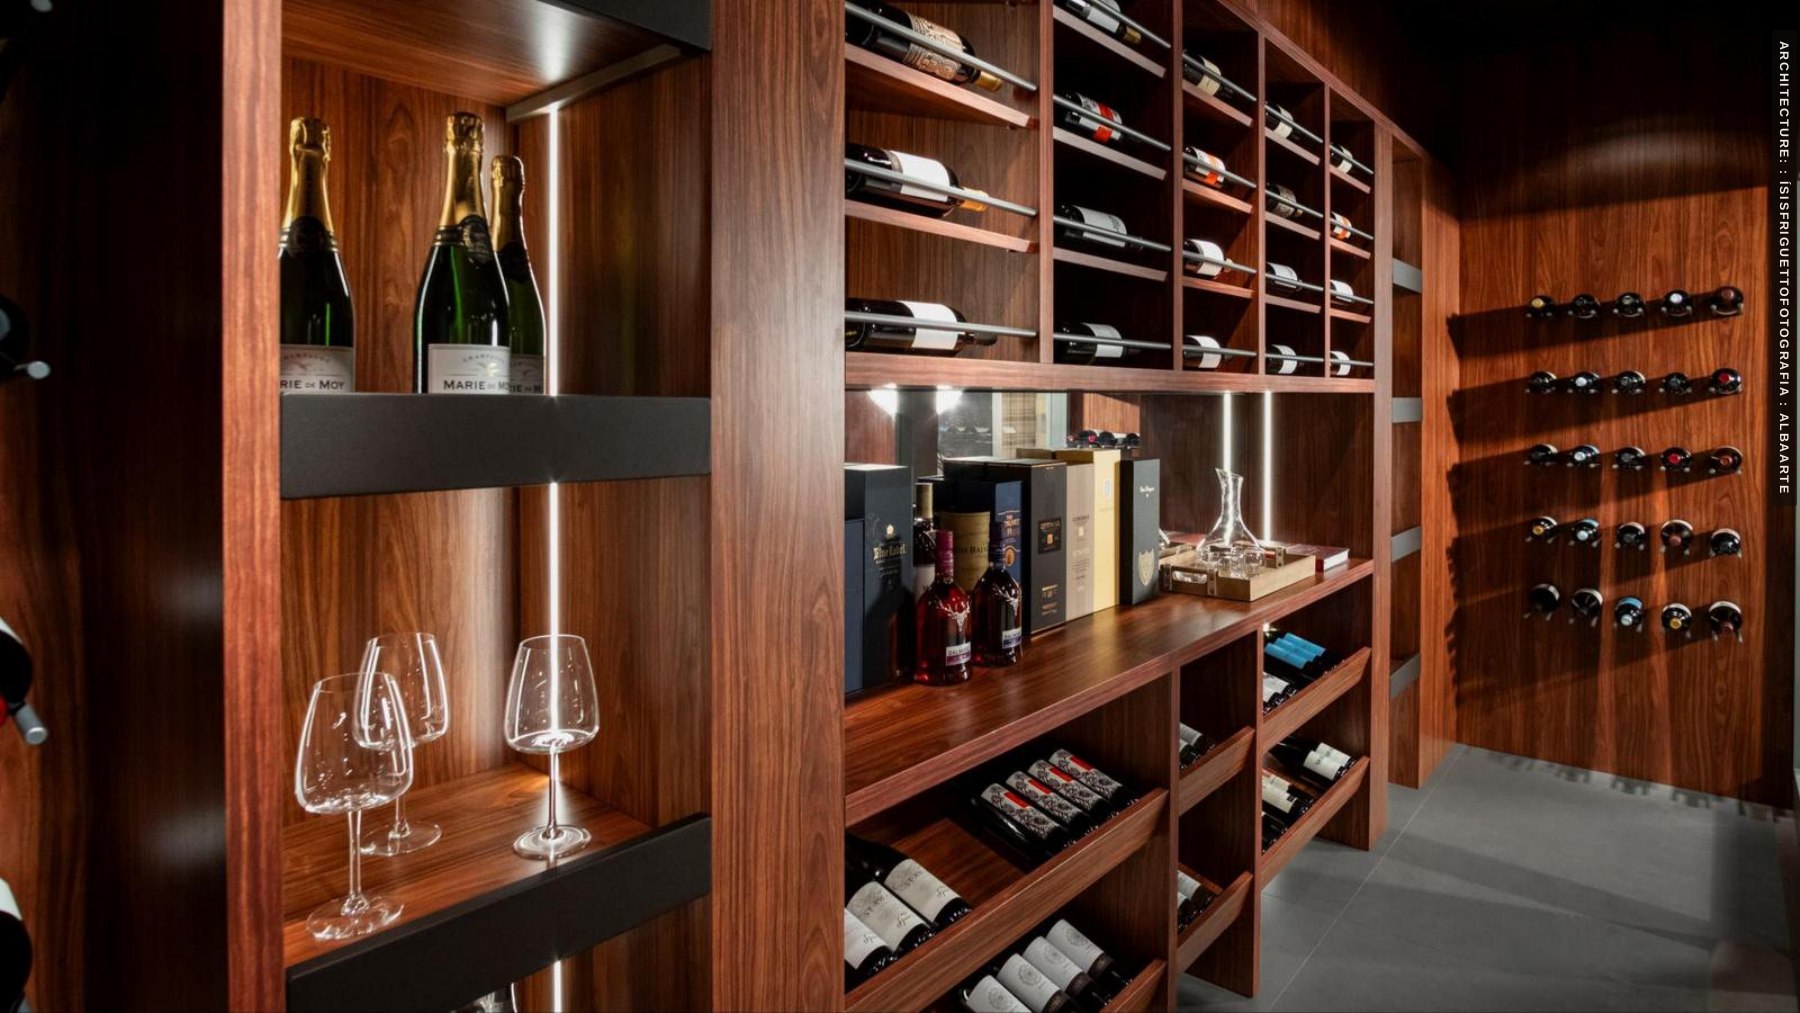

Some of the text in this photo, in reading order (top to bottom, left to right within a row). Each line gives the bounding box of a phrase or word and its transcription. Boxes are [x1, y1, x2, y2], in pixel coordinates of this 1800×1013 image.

[280, 380, 302, 389] RIE
[319, 380, 345, 390] MOY
[443, 380, 486, 390] MARIE
